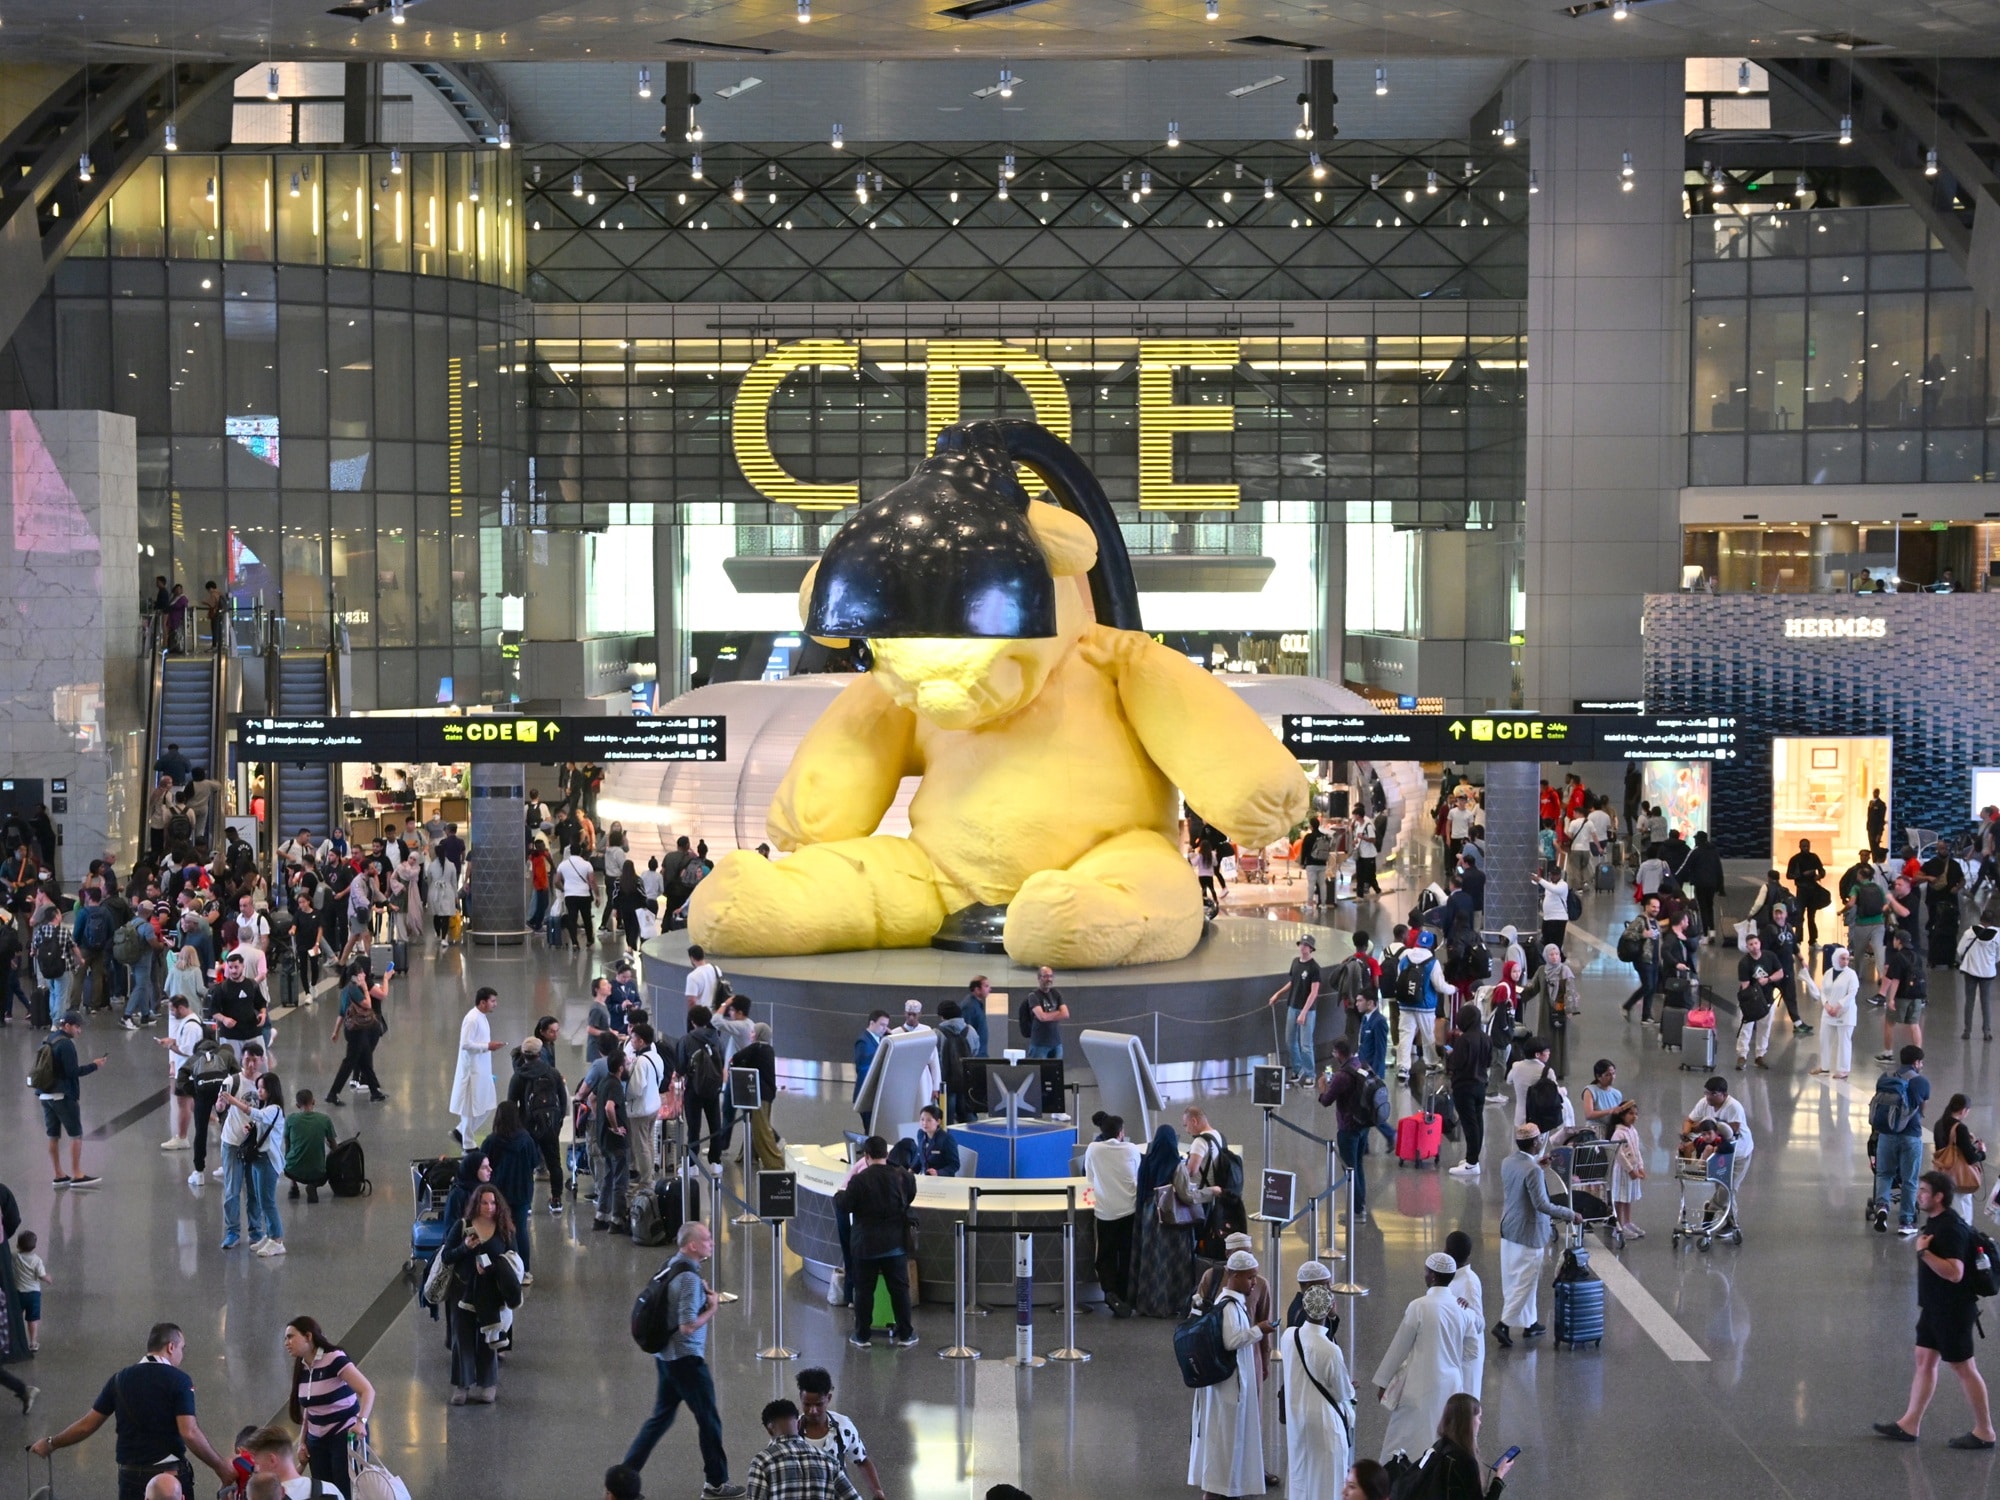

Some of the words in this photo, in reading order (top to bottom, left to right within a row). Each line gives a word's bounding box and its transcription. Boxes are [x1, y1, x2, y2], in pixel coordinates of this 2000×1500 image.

[1784, 616, 1887, 638] HERMÈS
[274, 721, 299, 729] Lounges
[466, 723, 513, 741] CDE
[1497, 722, 1544, 739] CDE
